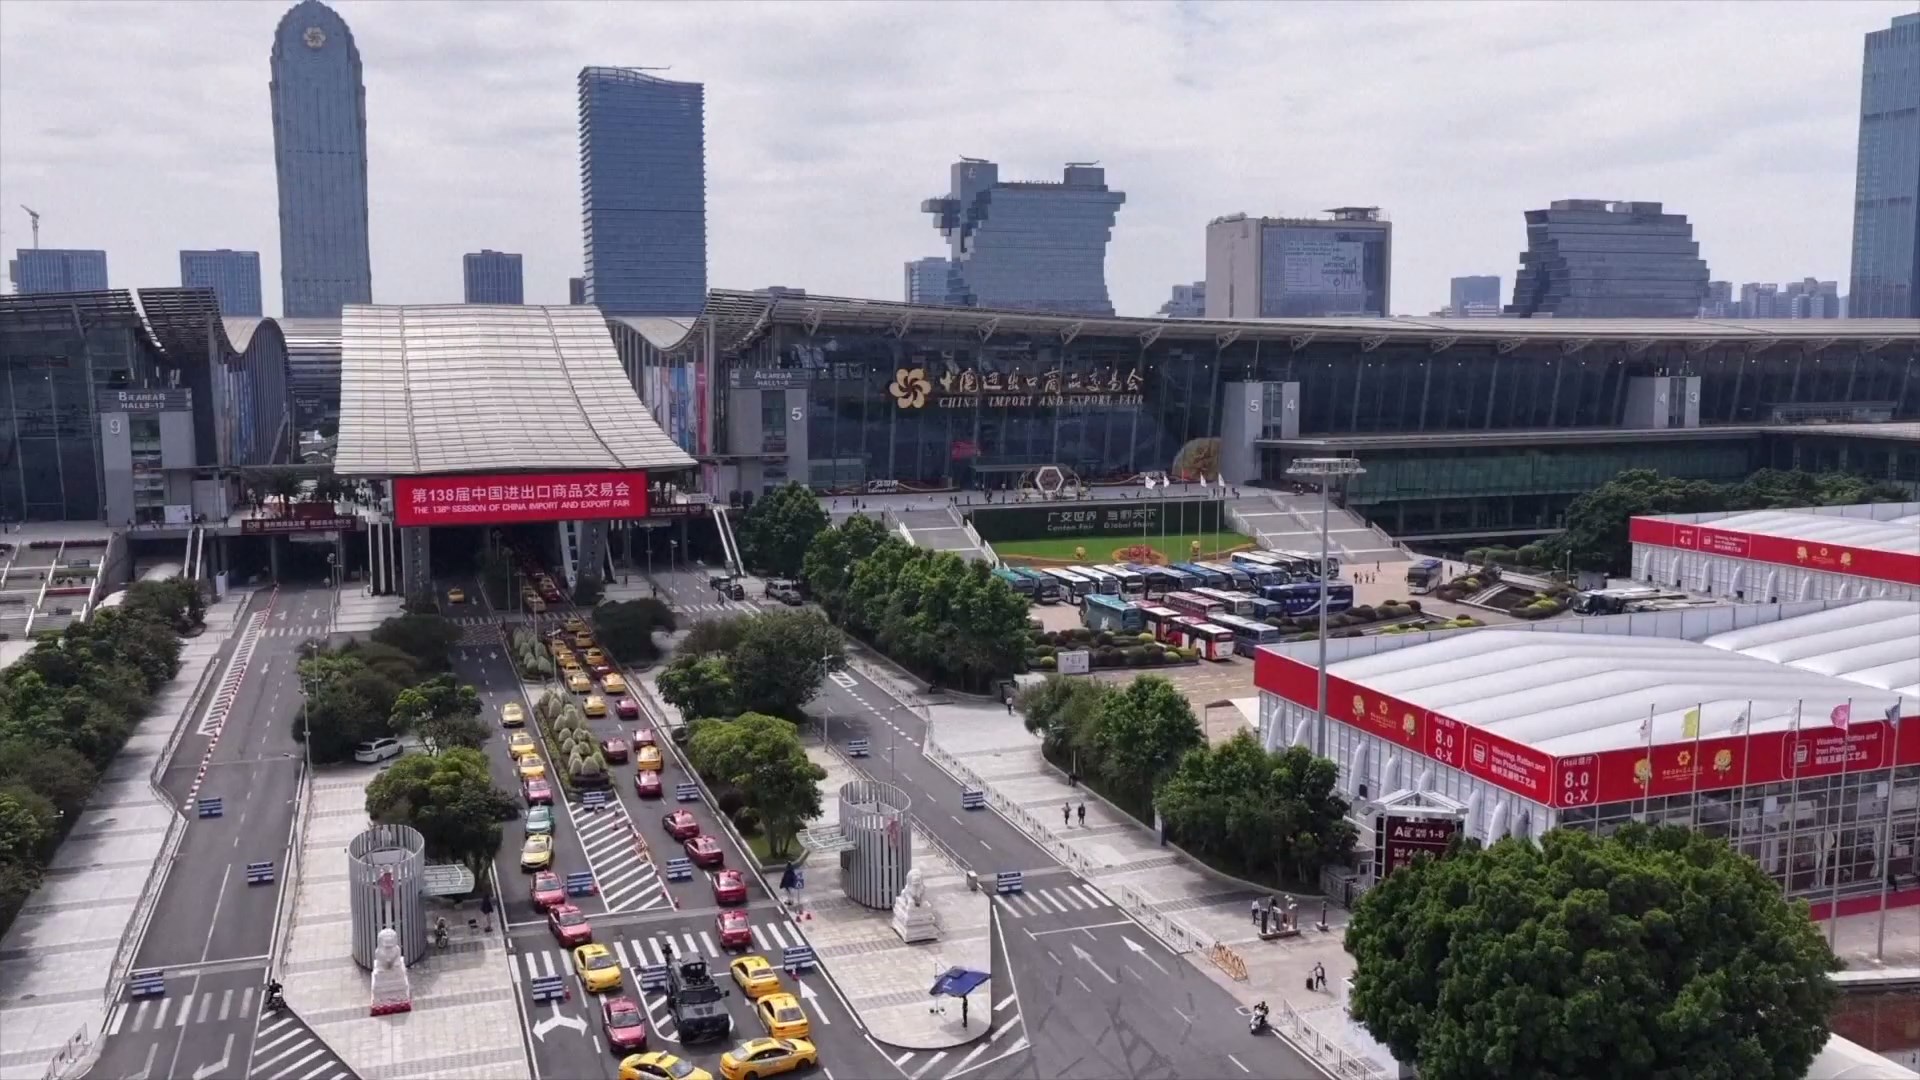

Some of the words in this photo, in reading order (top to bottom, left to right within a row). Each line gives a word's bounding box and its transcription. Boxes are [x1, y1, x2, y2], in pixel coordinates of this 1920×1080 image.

[939, 396, 979, 409] CHINA
[989, 395, 1034, 407] IMPORT
[1038, 395, 1064, 407] AND
[1069, 394, 1113, 406] EXPORT
[1119, 394, 1144, 405] FAIR
[1690, 391, 1698, 403] 3
[1250, 399, 1260, 412] 5
[1286, 399, 1296, 411] 4
[791, 407, 803, 421] 5
[110, 420, 121, 435] 9
[412, 482, 630, 503] 第138届中国进出口商品交易会
[413, 506, 429, 514] THE
[452, 504, 487, 513] SESSION
[489, 503, 500, 511] OF
[502, 502, 527, 511] CHINA
[529, 501, 558, 510] IMPORT
[561, 501, 579, 509] AND
[581, 500, 610, 509] EXPORT
[613, 499, 630, 508] FAIR
[1048, 511, 1097, 522] 广交世界
[1436, 728, 1453, 748] 8.0
[1564, 770, 1589, 788] 8.0
[1564, 788, 1589, 805] Q-X
[1429, 829, 1444, 839] 1-8
